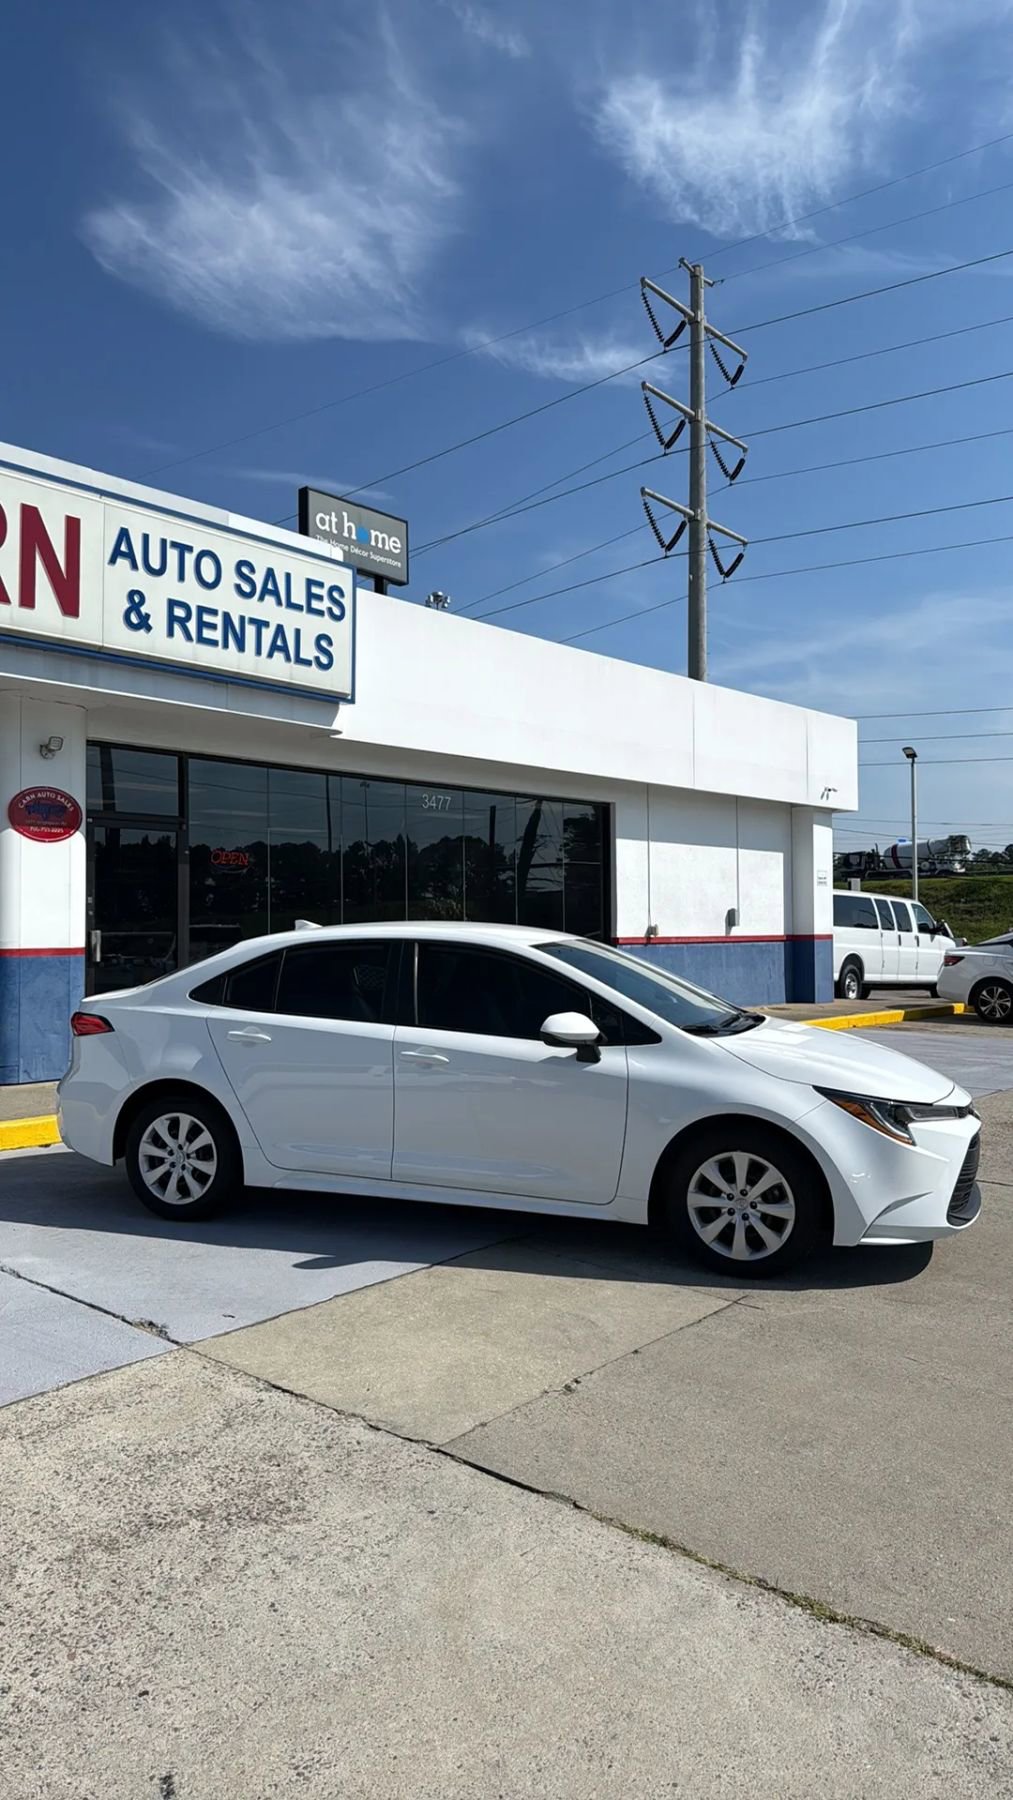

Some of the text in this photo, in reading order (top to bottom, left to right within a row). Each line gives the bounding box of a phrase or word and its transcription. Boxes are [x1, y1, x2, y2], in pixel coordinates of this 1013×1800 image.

[315, 511, 338, 534] at
[0, 501, 81, 619] N
[370, 552, 401, 568] Superstore
[107, 526, 347, 623] AUTO SALES
[123, 588, 335, 672] & RENTALS
[57, 795, 74, 811] SALES
[422, 793, 452, 811] 3477
[210, 849, 249, 865] OPEN
